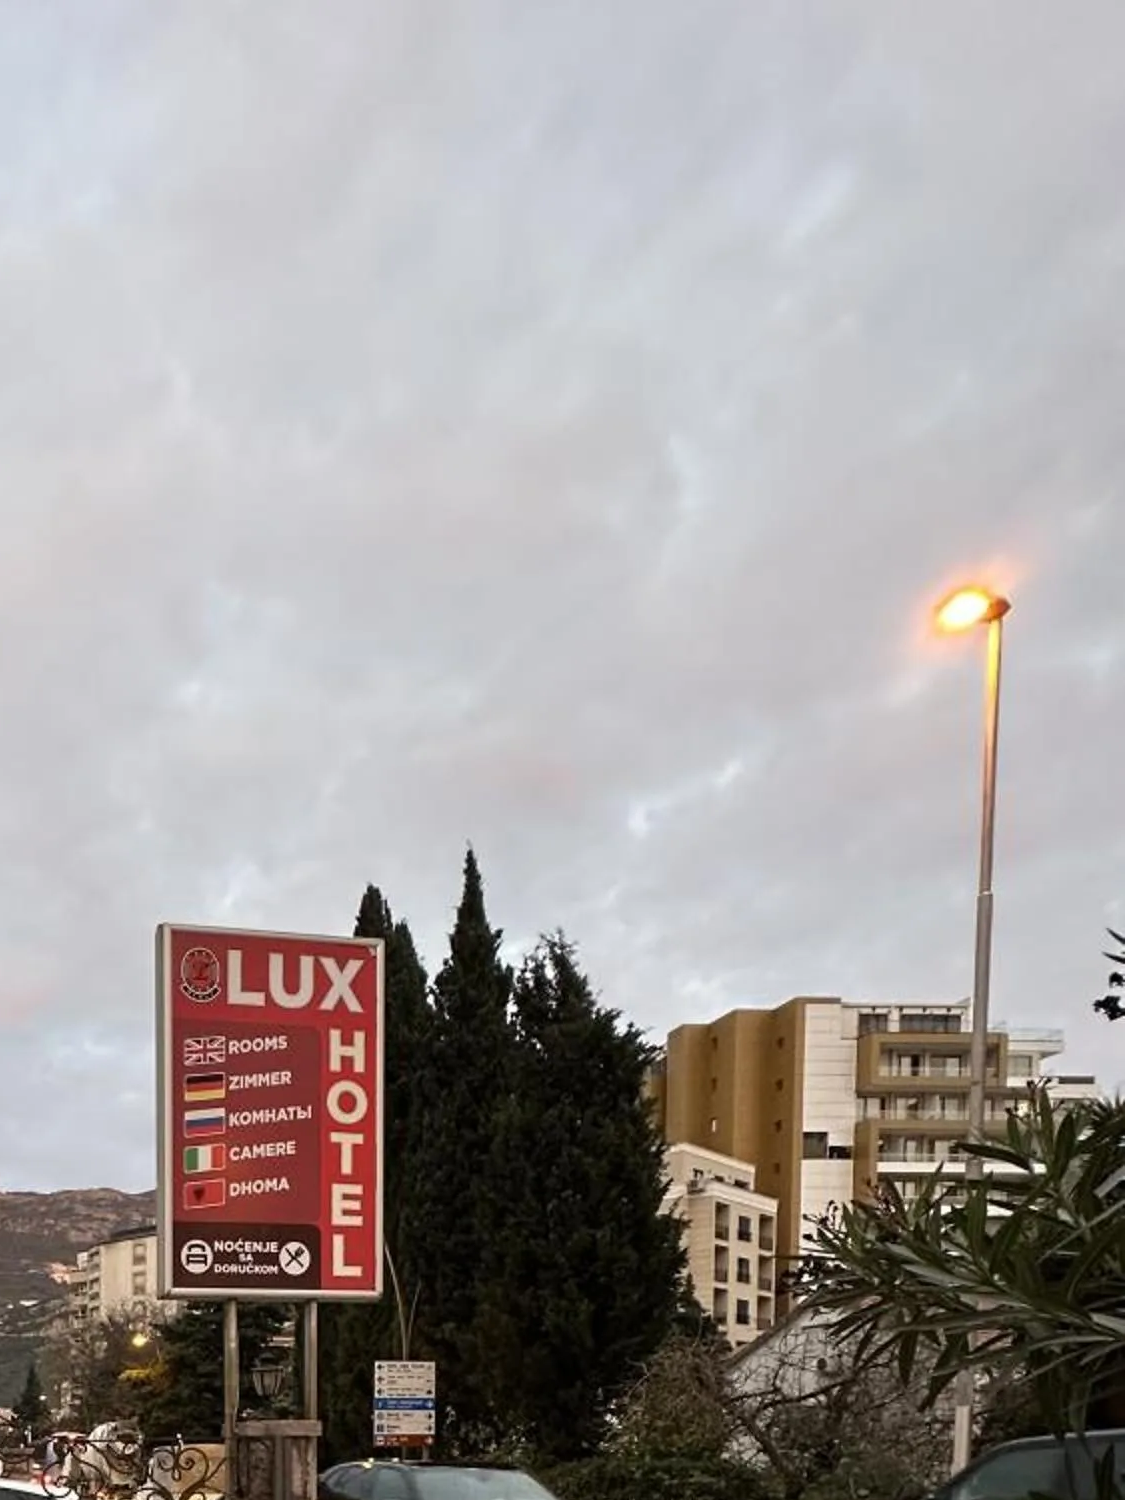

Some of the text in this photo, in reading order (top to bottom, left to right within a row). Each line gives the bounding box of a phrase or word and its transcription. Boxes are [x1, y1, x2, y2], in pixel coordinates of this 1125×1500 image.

[228, 950, 364, 1013] LUX
[228, 1036, 288, 1054] ROOMS
[229, 1071, 291, 1090] ZIMMER
[229, 1105, 312, 1127] КОМНАТЫ
[229, 1141, 296, 1161] CAMERE
[326, 1029, 368, 1277] HOTEL
[229, 1178, 289, 1197] DHOMA
[238, 1253, 254, 1263] SA
